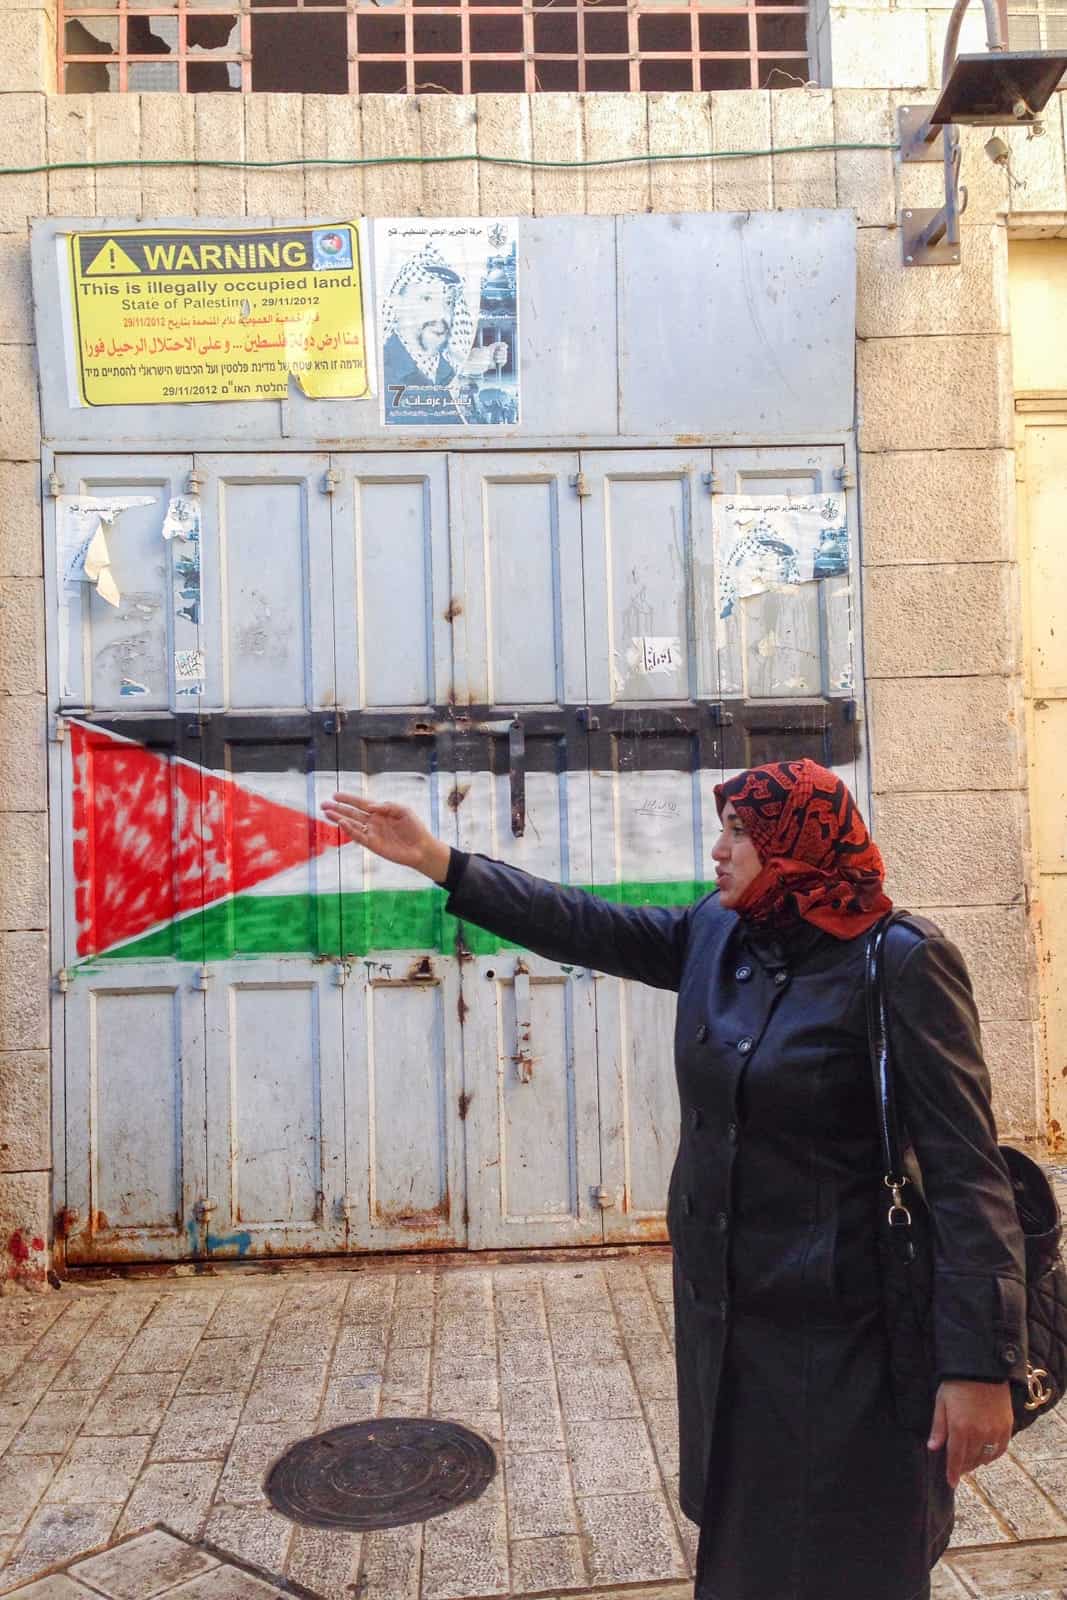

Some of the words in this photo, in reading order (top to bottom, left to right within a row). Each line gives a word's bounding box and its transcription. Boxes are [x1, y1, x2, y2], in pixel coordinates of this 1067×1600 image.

[143, 241, 307, 271] WARNING
[79, 283, 119, 295] This
[126, 282, 141, 294] is
[148, 280, 217, 296] illegally
[224, 277, 307, 292] occupied
[313, 275, 357, 289] land.
[121, 299, 160, 311] State
[164, 298, 178, 310] of
[261, 296, 320, 306] 29/11/2012
[123, 317, 165, 328] 29/11/2012
[167, 318, 191, 330] بتاريخ
[107, 335, 147, 357] الرحيل
[149, 335, 197, 354] الاحتلال
[138, 364, 173, 376] הישראלי
[176, 364, 204, 375] הכיבוש
[205, 362, 218, 375] ועל
[220, 360, 249, 376] פלסטין
[251, 361, 276, 373] מדינת
[277, 359, 289, 371] של
[293, 361, 312, 371] שטח
[315, 360, 329, 371] היא
[330, 360, 338, 370] זו
[340, 359, 363, 369] אדמה
[85, 367, 100, 377] מיד
[162, 385, 217, 396] 29/11/2012
[387, 384, 407, 408] 7
